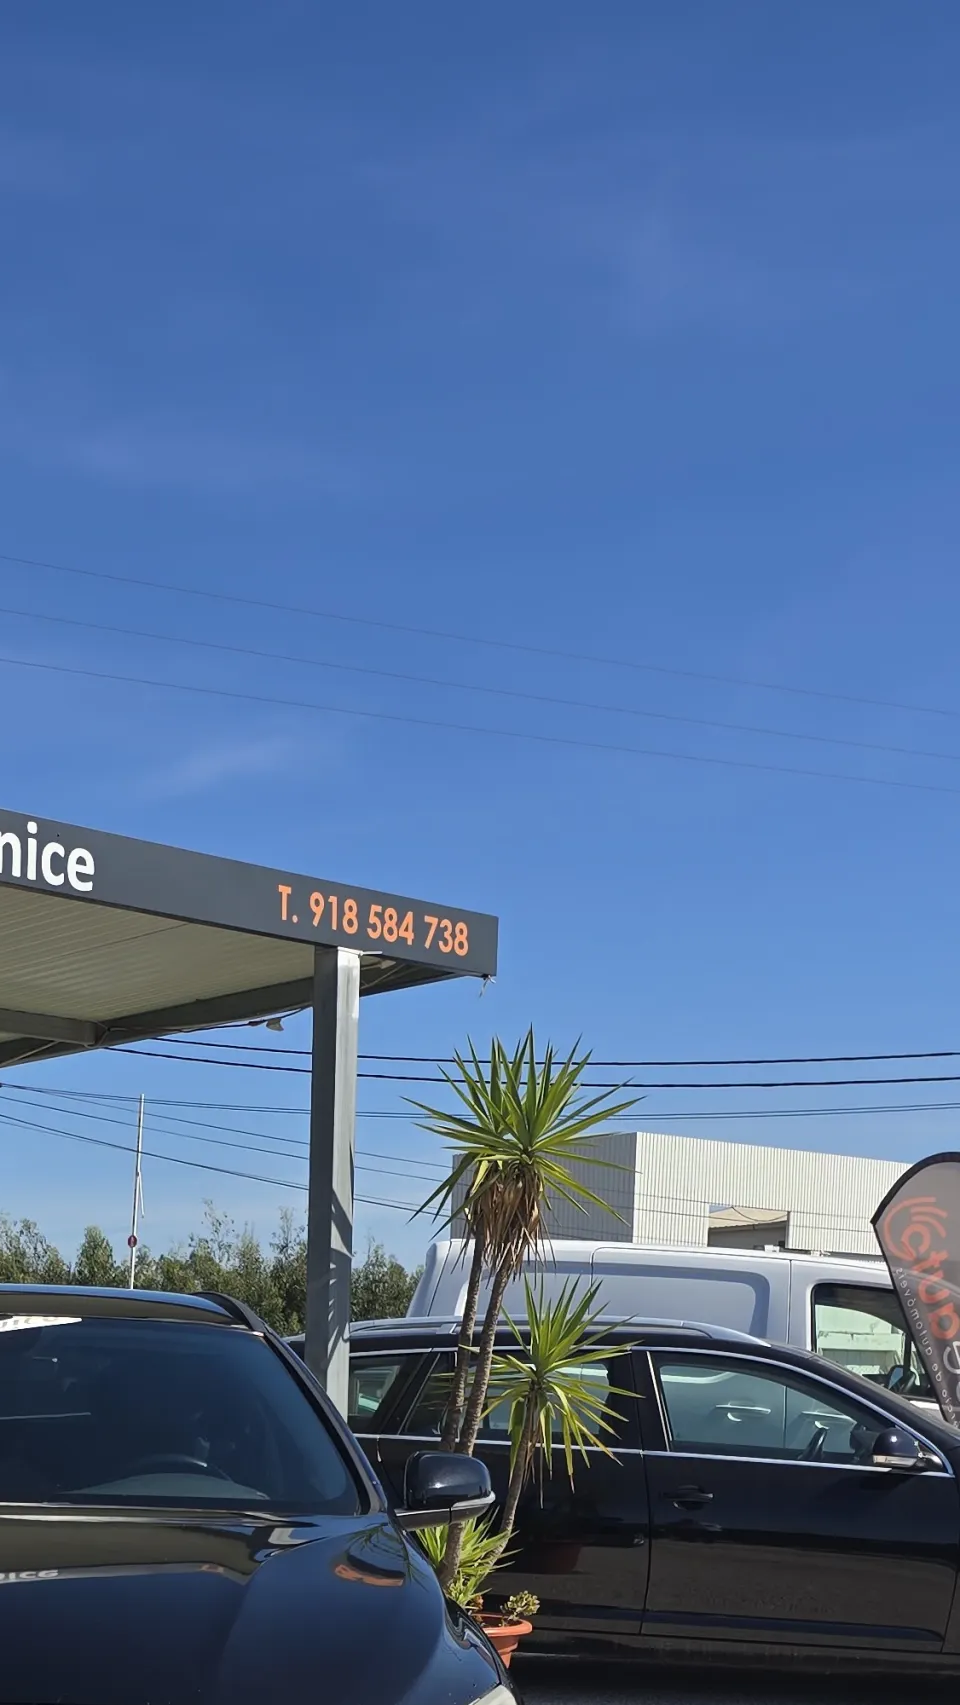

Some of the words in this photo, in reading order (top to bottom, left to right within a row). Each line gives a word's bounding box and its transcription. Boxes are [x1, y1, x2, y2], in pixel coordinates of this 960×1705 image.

[278, 884, 298, 924] T.
[309, 891, 359, 935] 918
[366, 904, 415, 945] 584
[424, 915, 469, 957] 738
